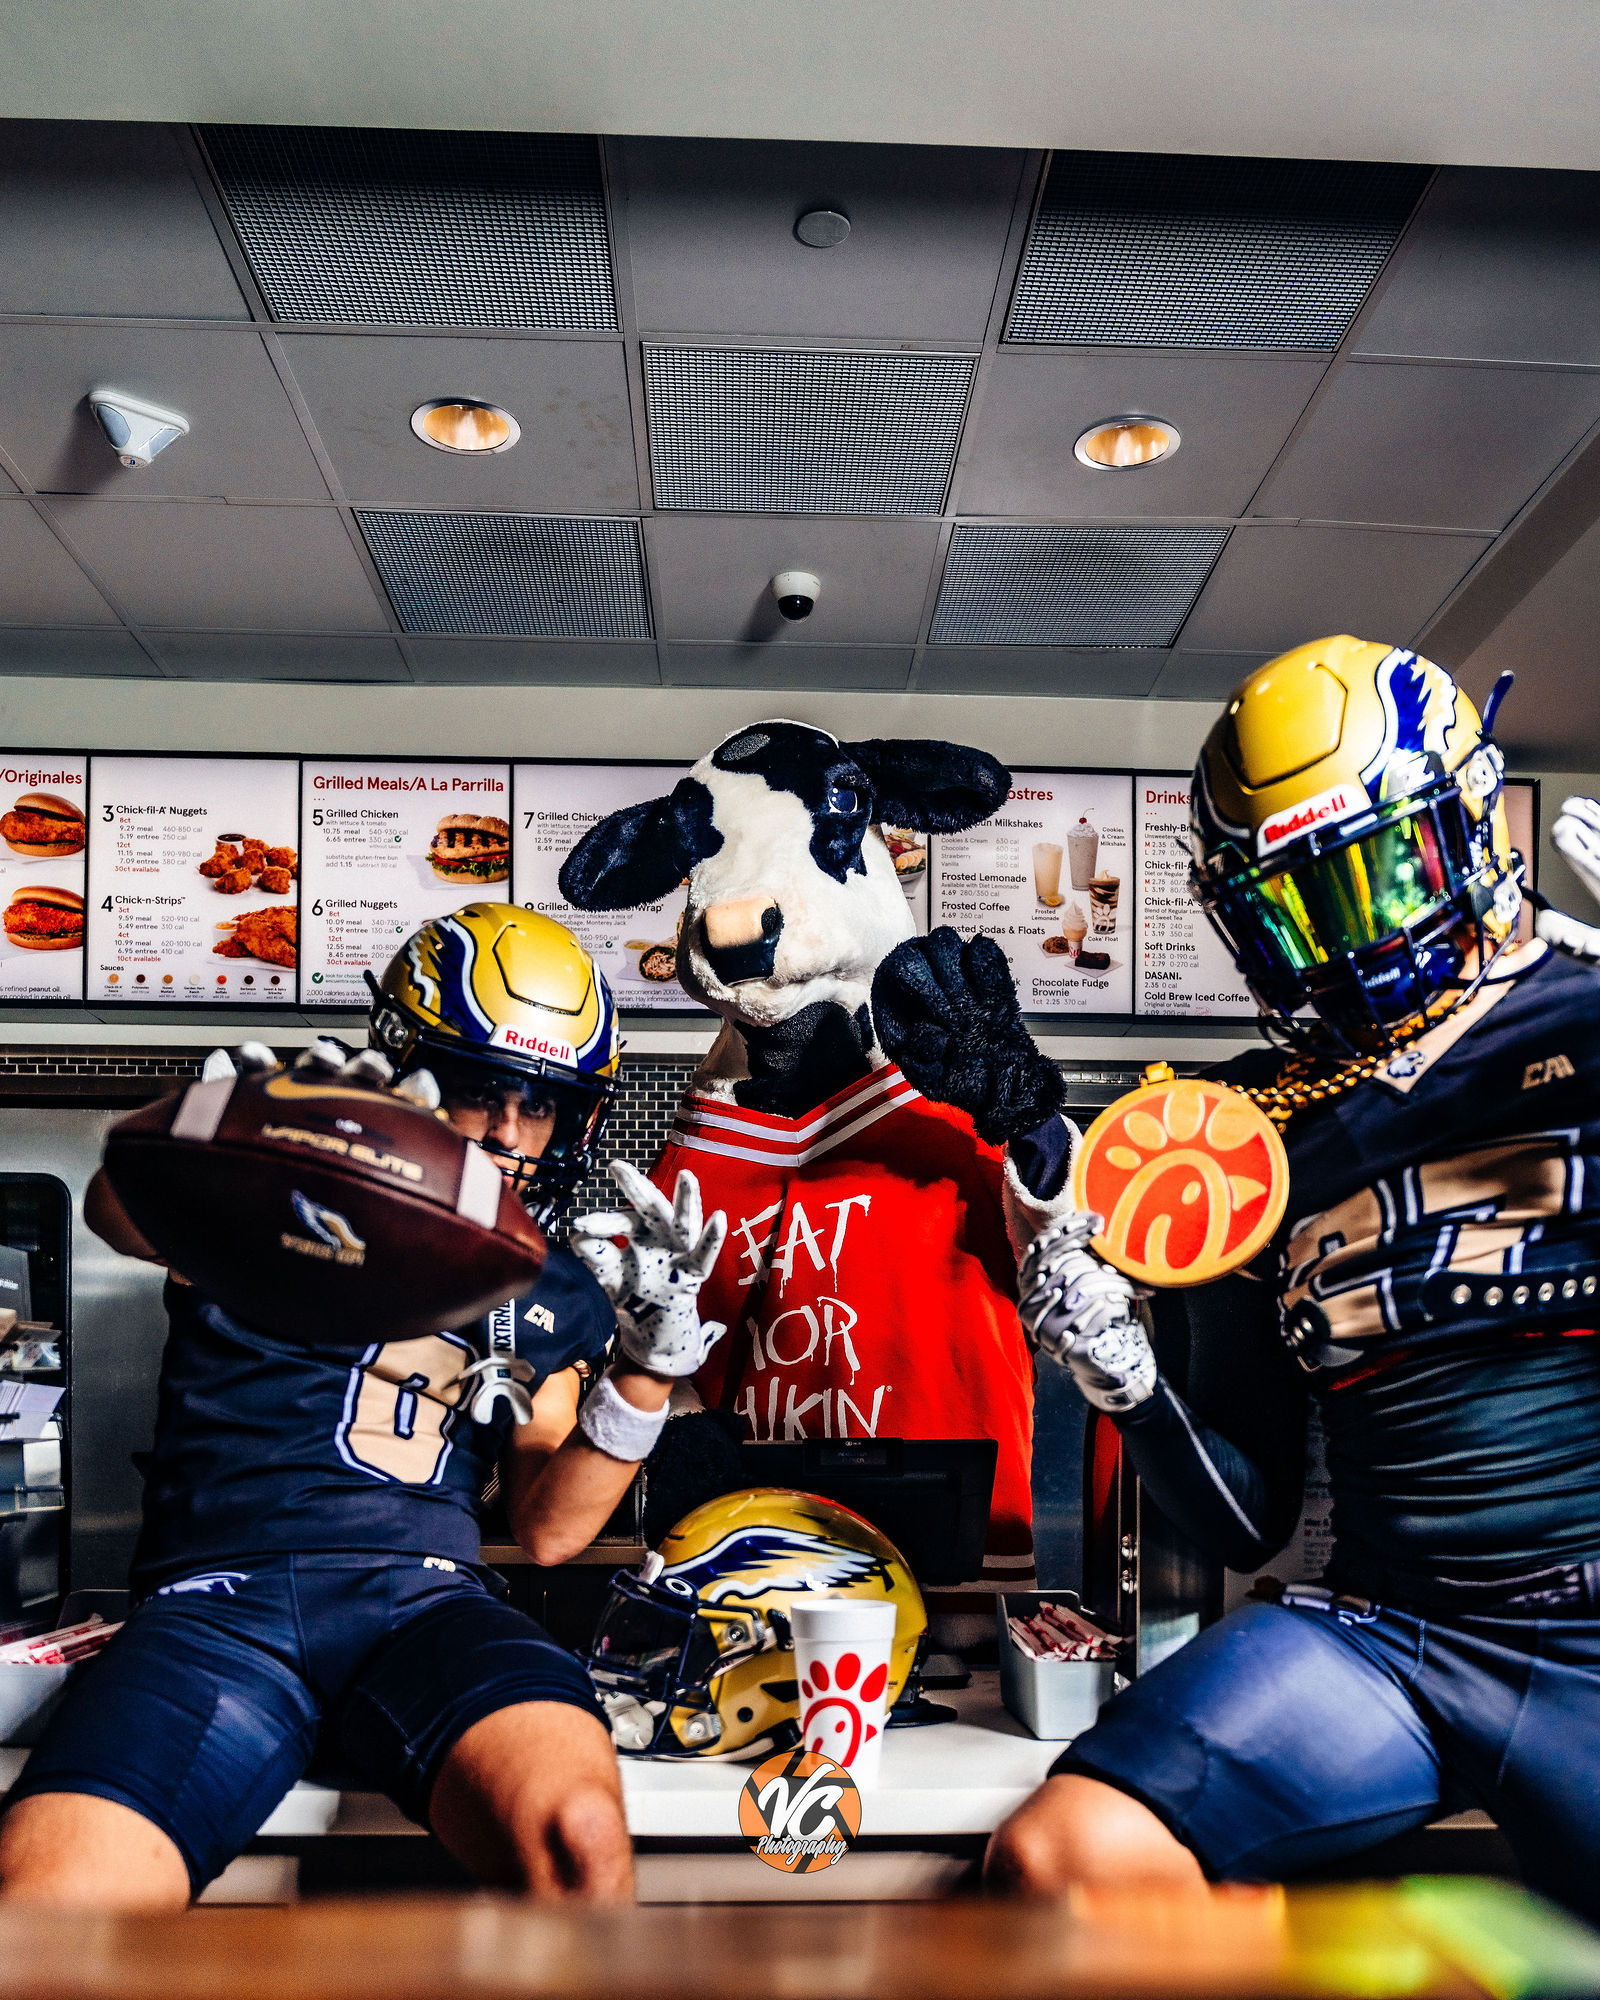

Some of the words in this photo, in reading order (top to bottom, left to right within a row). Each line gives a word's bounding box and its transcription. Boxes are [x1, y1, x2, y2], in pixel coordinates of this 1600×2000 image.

[313, 776, 364, 790] Grilled
[367, 776, 428, 791] Meals/A
[431, 777, 448, 791] La
[452, 778, 504, 792] Parrilla
[1006, 787, 1054, 801] ostres
[102, 805, 115, 822] 3
[169, 806, 208, 817] Nuggets
[326, 809, 358, 818] Grilled
[360, 809, 399, 819] Chicken
[537, 812, 569, 821] Grilled
[312, 809, 324, 826] 5
[523, 811, 535, 829] 7
[994, 818, 1044, 829] Milkshakes
[1145, 822, 1191, 833] Freshly-Br
[941, 872, 977, 881] Frosted
[979, 873, 1028, 883] Lemonade
[100, 895, 114, 912] 4
[311, 899, 324, 916] 6
[325, 899, 357, 908] Grilled
[360, 899, 398, 910] Nuggets
[537, 902, 569, 911] Grilled
[941, 901, 977, 910] Frosted
[979, 902, 1011, 912] Coffee
[979, 925, 1007, 934] Sodas
[1008, 925, 1015, 934] &
[1018, 925, 1046, 935] Floats
[1144, 941, 1164, 951] Soft
[1165, 942, 1196, 952] Drinks
[1031, 978, 1080, 988] Chocolate
[1081, 979, 1110, 990] Fudge
[1032, 987, 1070, 997] Brownie
[1144, 991, 1166, 1000] Cold
[1168, 992, 1193, 1001] Brew
[1195, 992, 1216, 1002] Iced
[1217, 993, 1251, 1003] Coffee
[505, 1029, 570, 1060] Riddell
[731, 1193, 873, 1299] EAT
